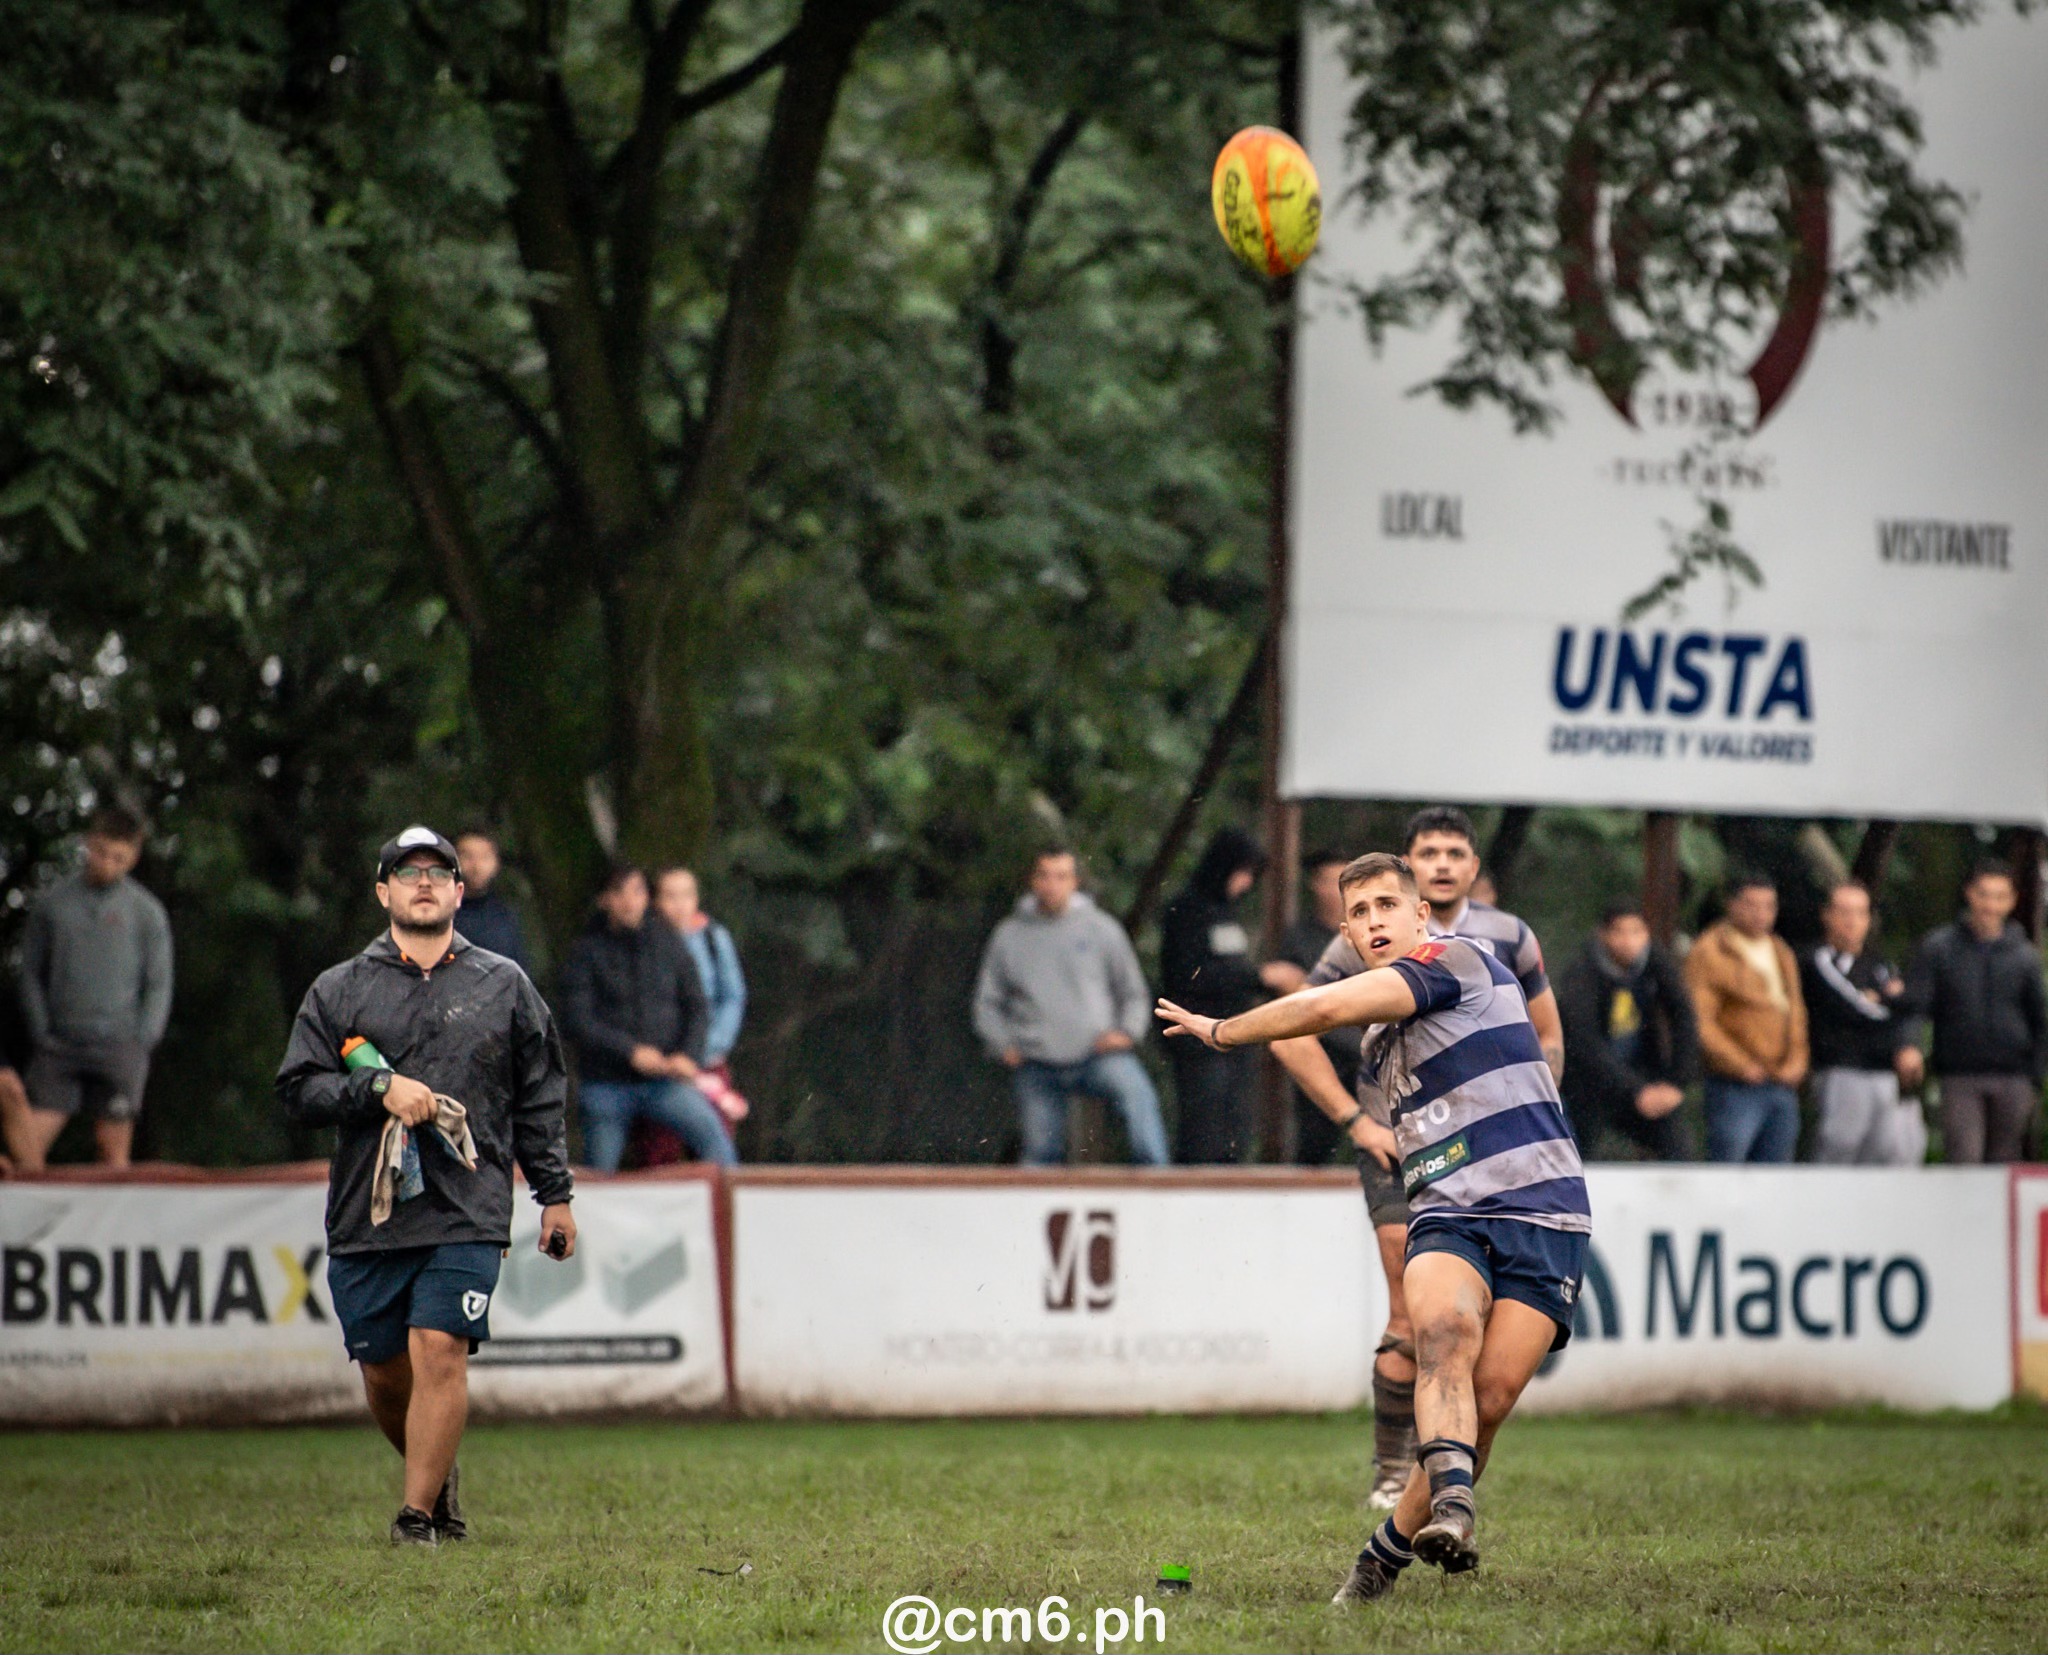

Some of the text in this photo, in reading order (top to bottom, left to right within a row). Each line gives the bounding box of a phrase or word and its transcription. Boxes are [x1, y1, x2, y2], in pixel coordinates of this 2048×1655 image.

[1381, 494, 1463, 540] LOCAL
[1877, 520, 2012, 570] VISITANTE
[1552, 626, 1814, 720] UNSTA
[1549, 727, 1814, 764] DEPORTE Y VALORES
[3, 1245, 328, 1326] BRIMAX
[1644, 1228, 1930, 1340] Macro
